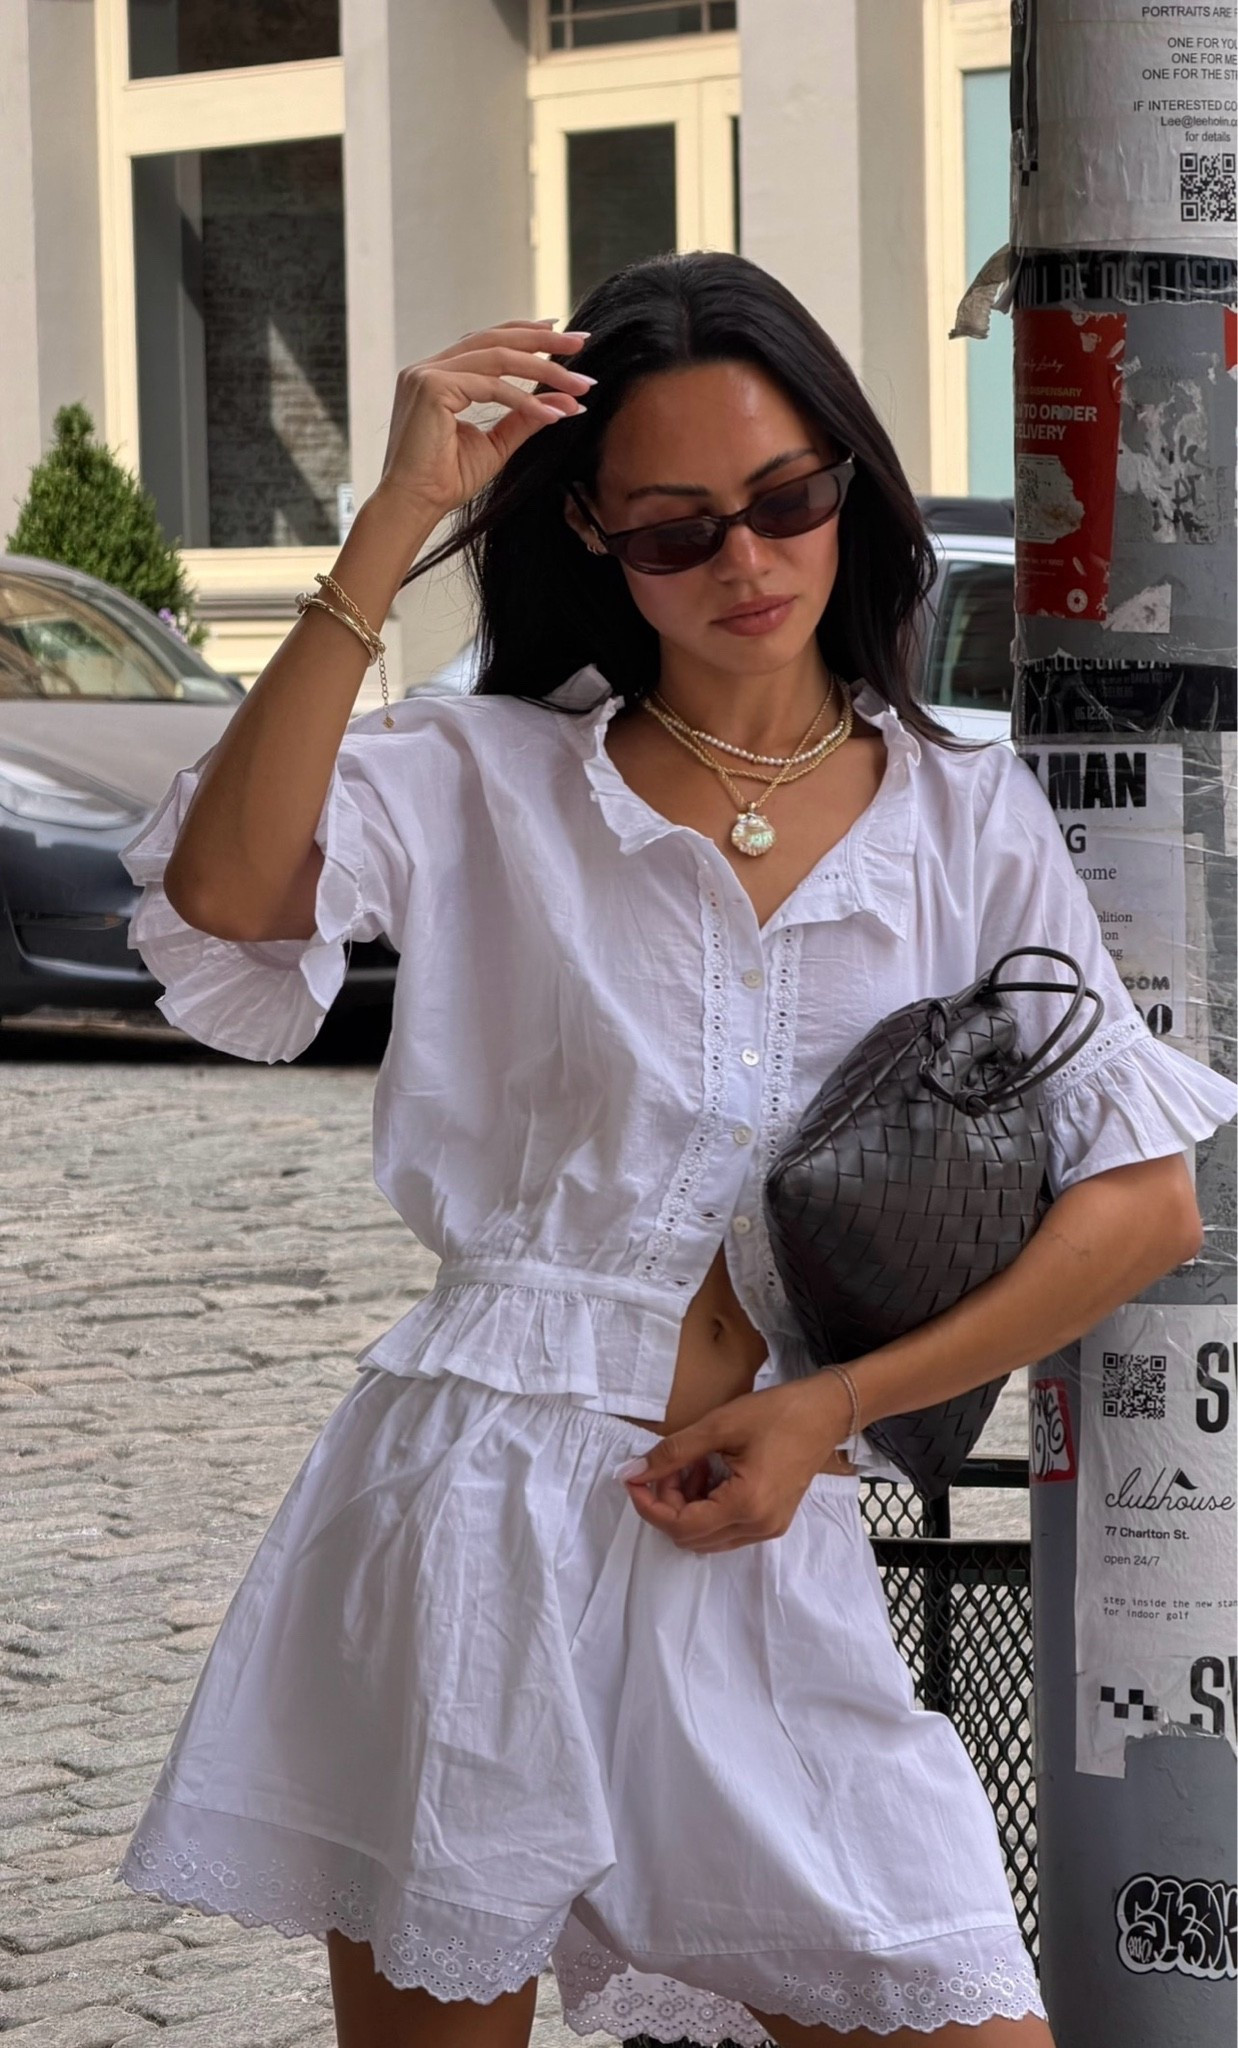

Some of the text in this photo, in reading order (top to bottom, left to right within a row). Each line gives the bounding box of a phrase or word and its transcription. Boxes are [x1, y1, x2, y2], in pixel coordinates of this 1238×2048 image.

[1142, 6, 1210, 17] PORTRAITS
[1213, 7, 1232, 18] ARE
[1167, 37, 1194, 48] ONE
[1197, 37, 1219, 48] FOR
[1171, 53, 1237, 66] ONE FOR ME
[1142, 69, 1170, 80] ONE
[1173, 69, 1198, 80] FOR
[1201, 69, 1222, 80] THE
[1134, 100, 1144, 111] IF
[1149, 100, 1222, 111] INTERESTED
[1185, 131, 1231, 142] for details
[1040, 404, 1098, 422] ORDER
[1024, 752, 1147, 811] MAN
[1059, 823, 1087, 854] G
[1196, 1341, 1238, 1434] S
[1105, 1466, 1236, 1511] clubhouse
[1104, 1525, 1190, 1540] 77 Charlton St.
[1103, 1554, 1160, 1567] open 24/7
[1103, 1596, 1126, 1607] step
[1132, 1598, 1167, 1608] inside
[1173, 1599, 1190, 1609] the
[1195, 1600, 1213, 1609] new
[1103, 1607, 1190, 1622] for indoor golf
